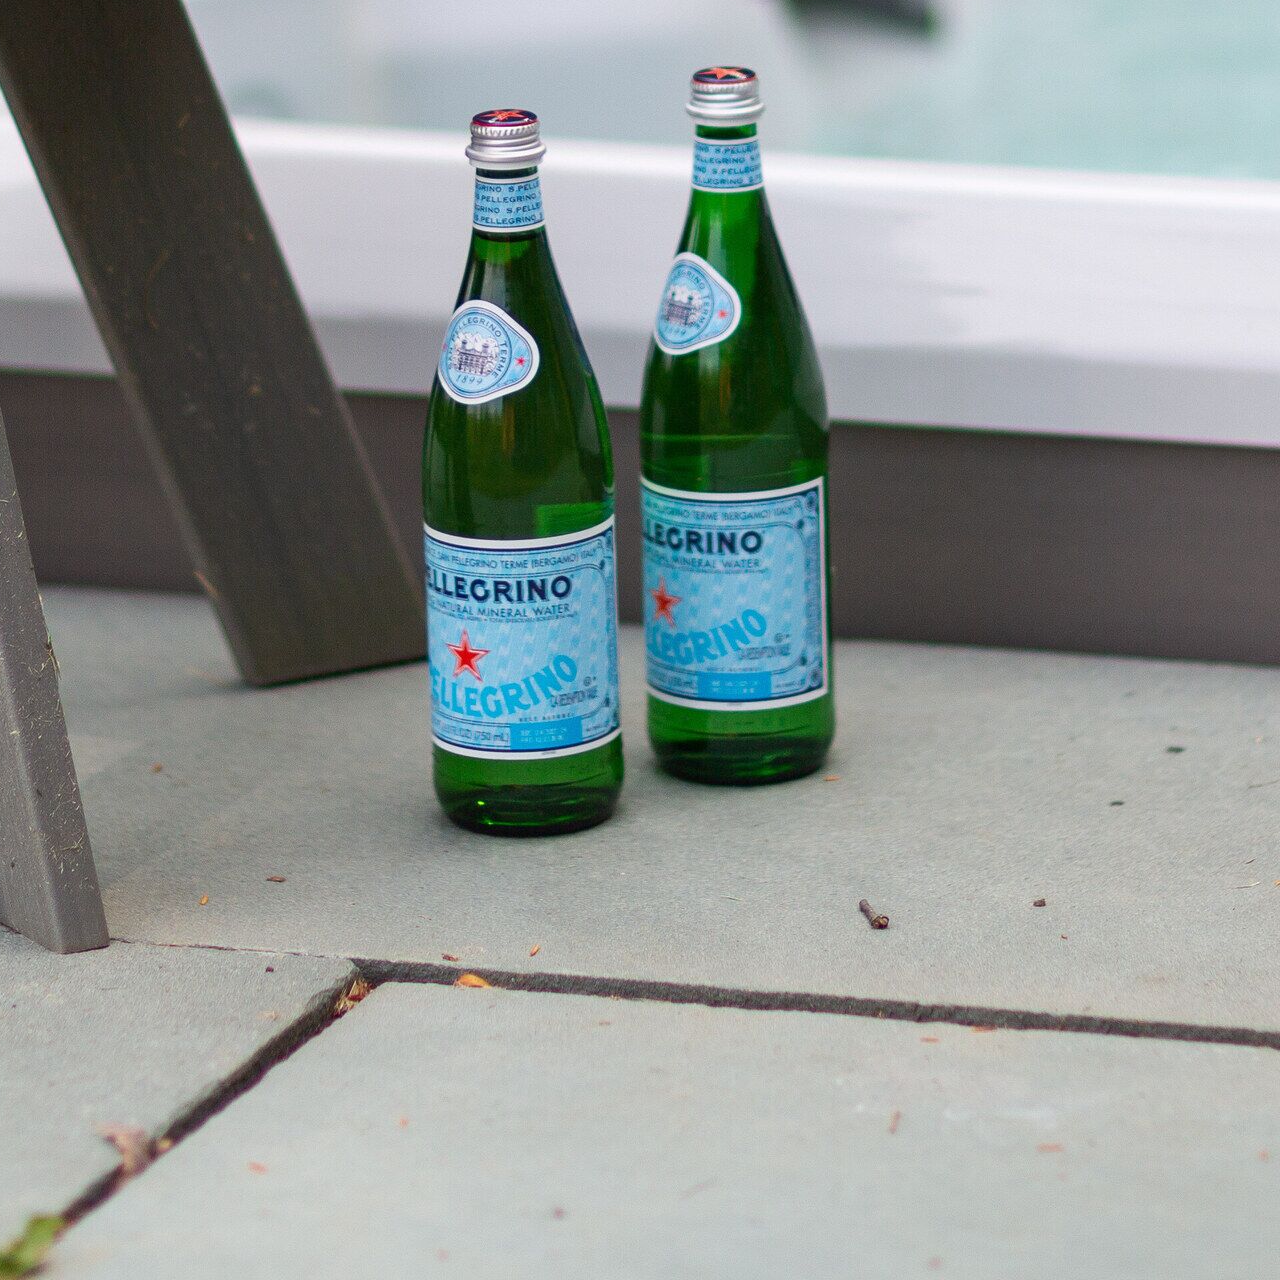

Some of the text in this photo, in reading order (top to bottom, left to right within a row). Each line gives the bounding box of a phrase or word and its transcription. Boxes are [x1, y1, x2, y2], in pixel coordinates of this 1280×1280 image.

[643, 518, 763, 555] LEGRINO
[500, 559, 529, 569] TERME
[477, 606, 528, 619] MINERAL
[532, 603, 570, 617] WATER
